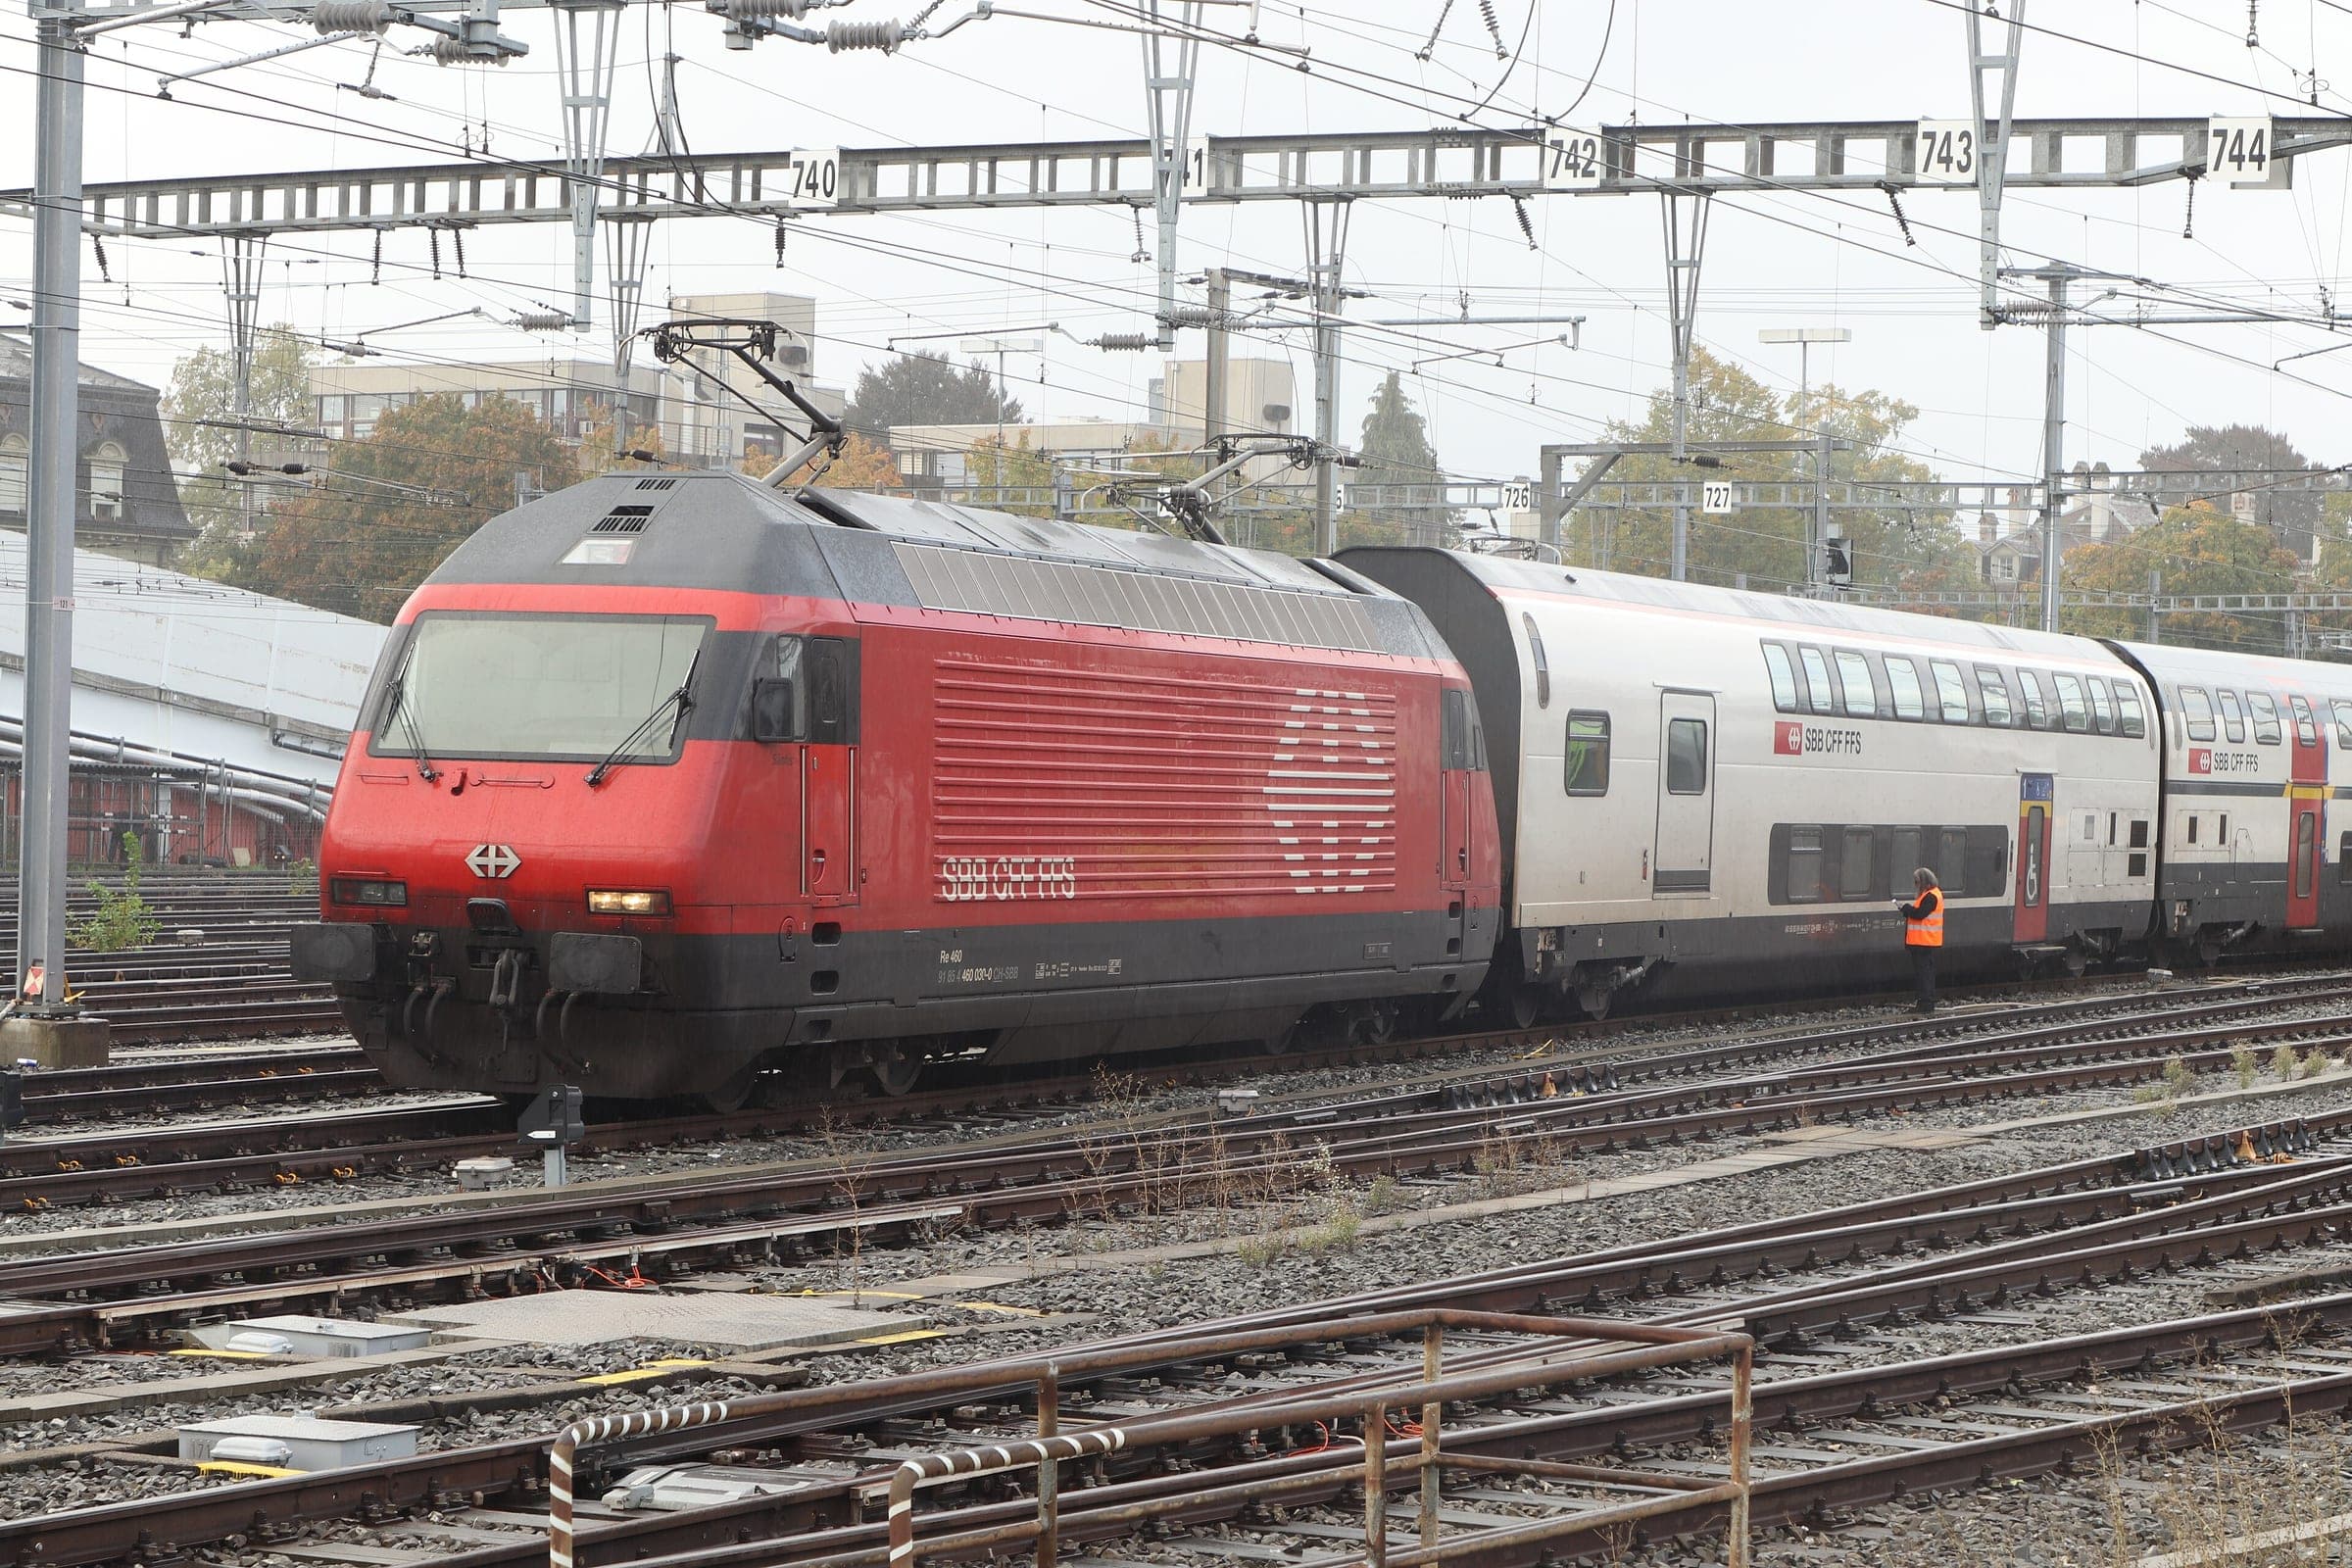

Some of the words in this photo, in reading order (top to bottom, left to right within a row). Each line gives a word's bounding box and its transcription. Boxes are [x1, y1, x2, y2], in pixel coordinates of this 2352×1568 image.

[1550, 138, 1595, 178] 742
[1923, 129, 1972, 172] 743
[2213, 128, 2266, 172] 744
[793, 159, 835, 198] 740
[1505, 486, 1529, 508] 726
[1706, 487, 1729, 508] 727
[1805, 727, 1823, 752] SBB
[1826, 729, 1842, 753] CFF
[1844, 731, 1861, 754] FFS
[2214, 753, 2229, 770] SBB
[2231, 753, 2243, 771] CFF
[2246, 754, 2258, 772] FFS
[942, 857, 988, 902] SBB
[993, 857, 1036, 901] CFF
[1039, 857, 1075, 900] FFS
[940, 950, 950, 963] Re
[950, 949, 962, 963] 460
[961, 967, 974, 982] 460
